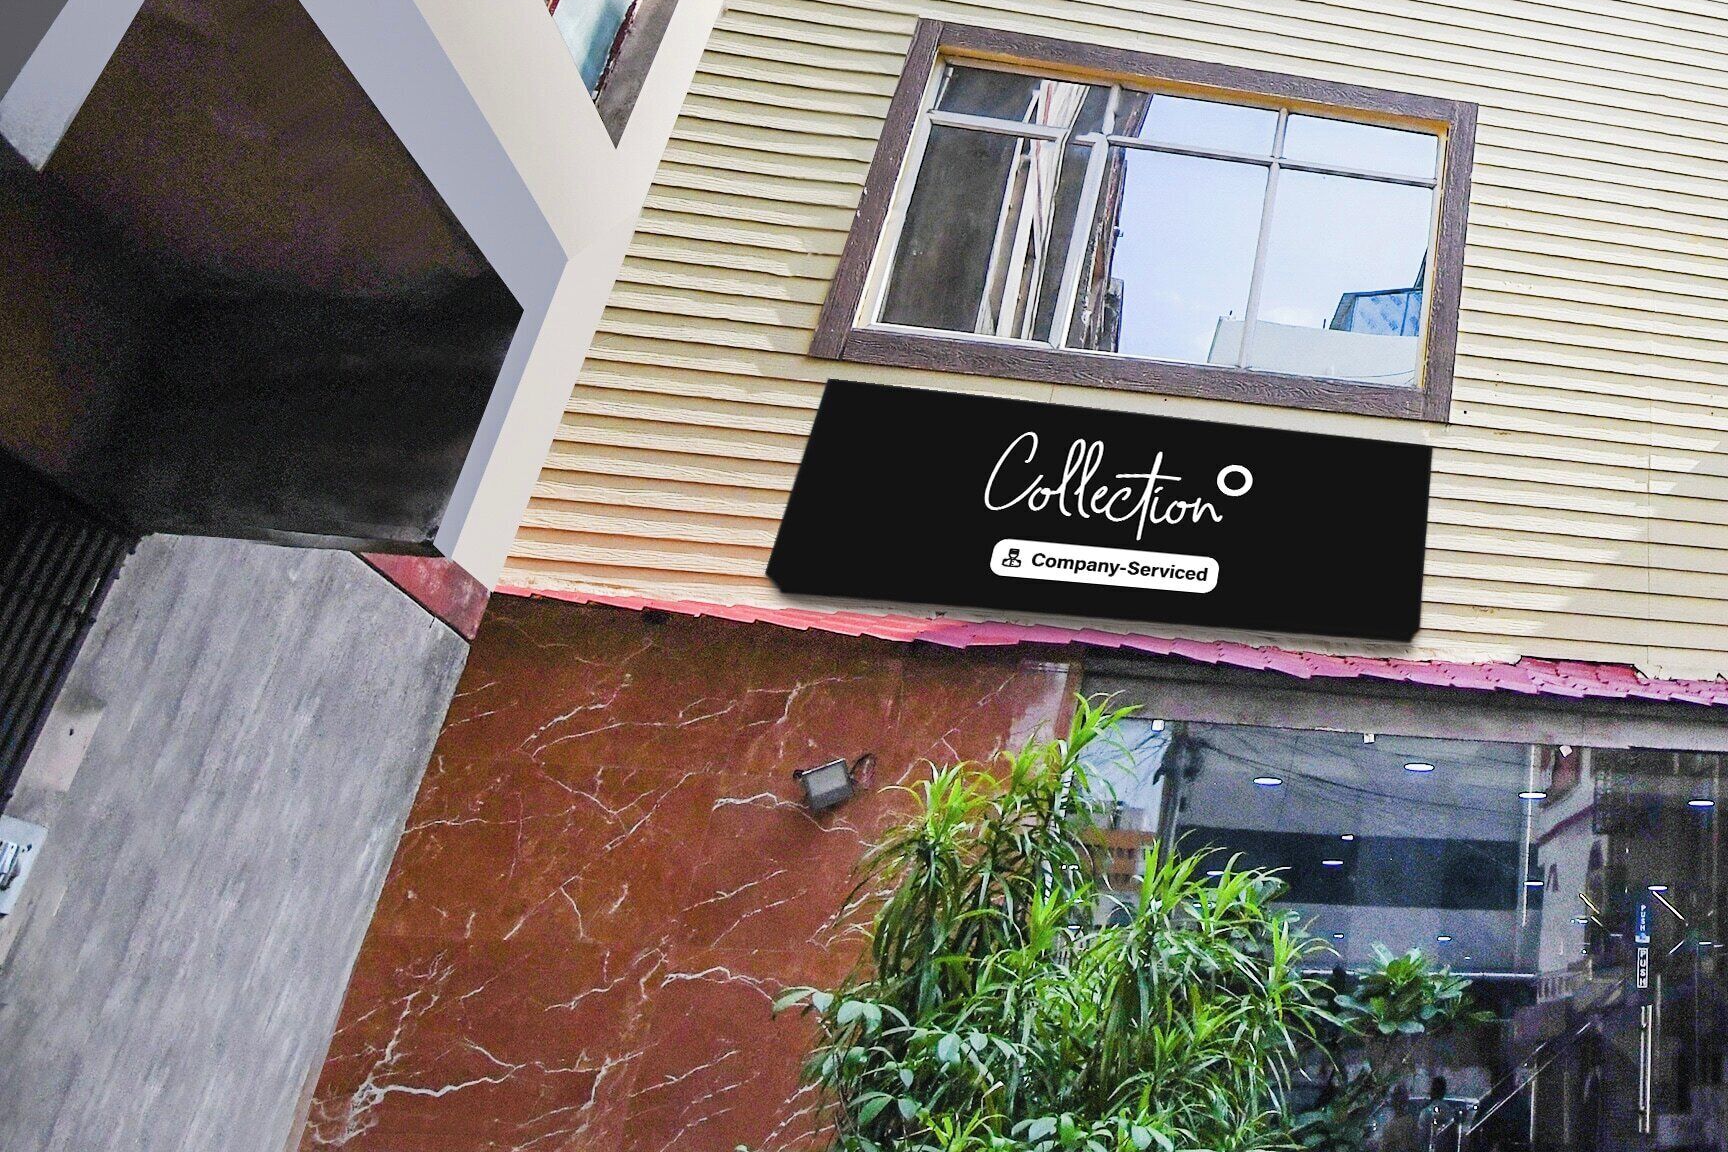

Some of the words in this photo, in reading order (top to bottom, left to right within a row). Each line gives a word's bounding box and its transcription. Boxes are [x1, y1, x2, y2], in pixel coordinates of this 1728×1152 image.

[984, 431, 1223, 541] Collection
[1031, 553, 1209, 582] Company-Serviced
[1639, 949, 1647, 986] PUSH
